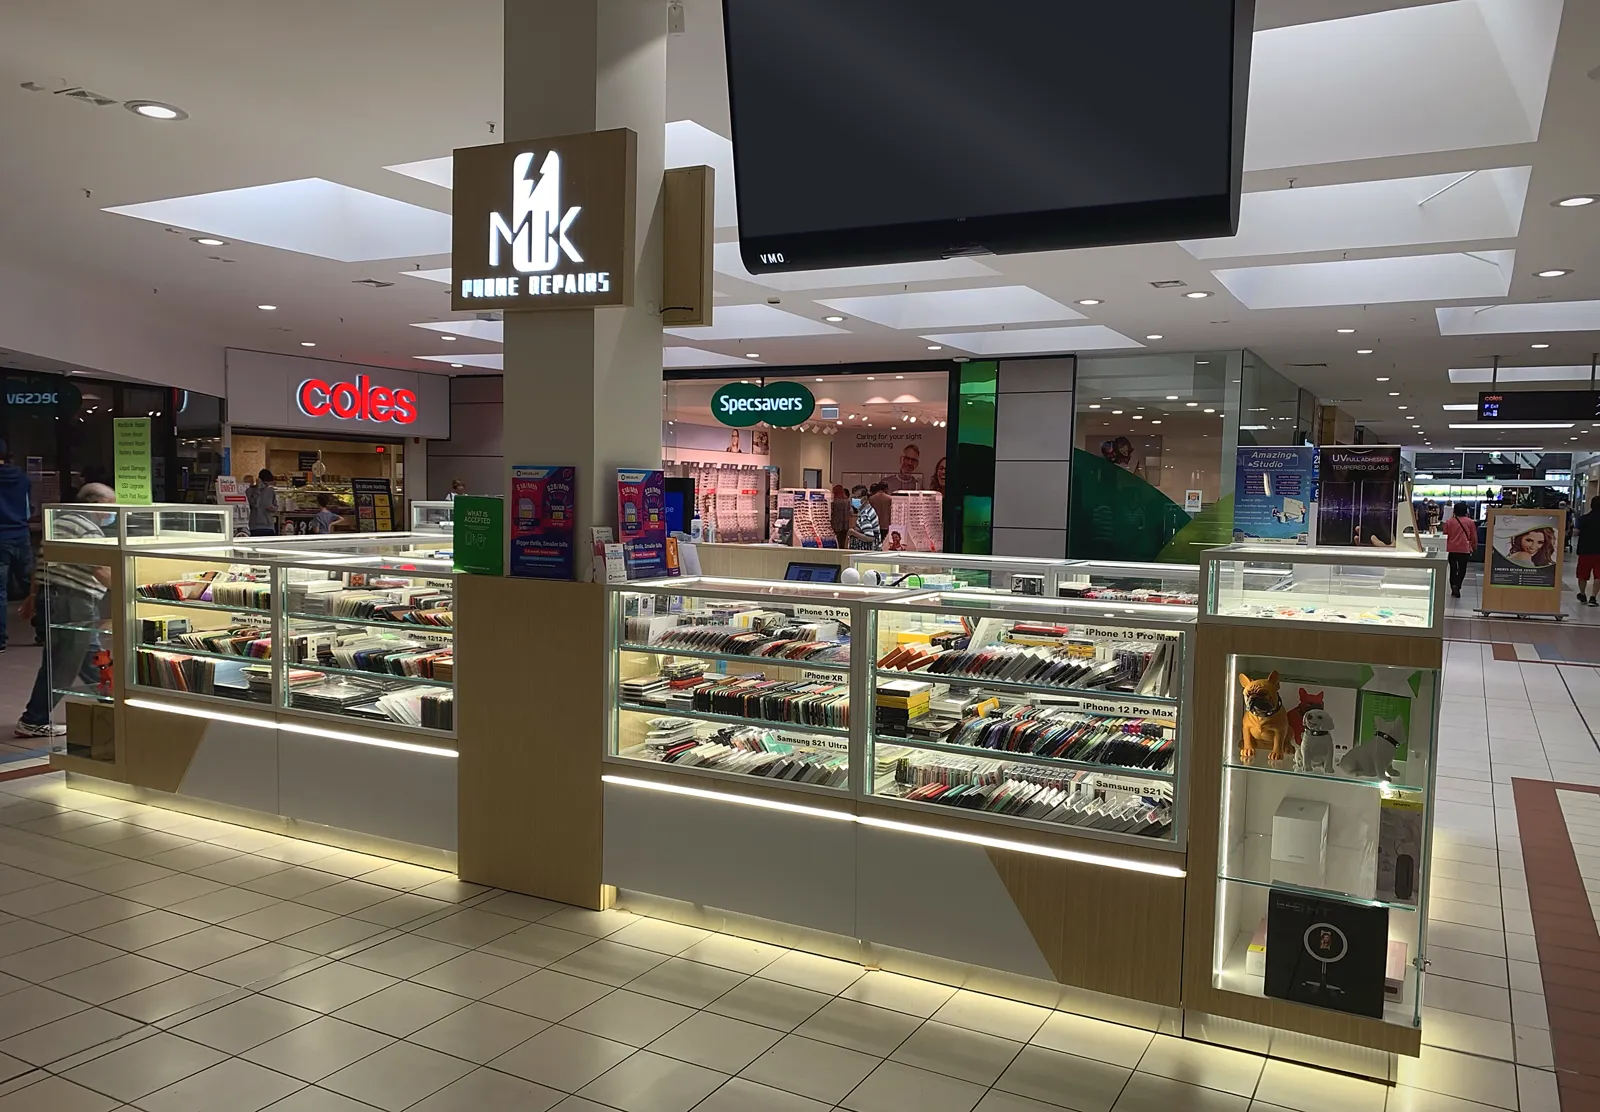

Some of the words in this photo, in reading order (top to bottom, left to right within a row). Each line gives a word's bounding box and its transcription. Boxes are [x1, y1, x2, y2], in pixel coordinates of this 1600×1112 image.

[489, 206, 585, 267] MK
[760, 252, 784, 264] VMO
[461, 277, 519, 298] PHONE
[528, 272, 610, 296] REPAIRS
[297, 374, 417, 424] coles
[720, 395, 803, 415] Specsavers
[1085, 628, 1119, 638] iPhone
[1137, 632, 1153, 640] Pro
[805, 672, 830, 680] iPhone
[1083, 703, 1115, 712] iPhone
[1152, 709, 1173, 717] Max
[777, 735, 810, 746] Samsung
[1096, 780, 1140, 794] Samsung
[1143, 787, 1161, 796] S21
